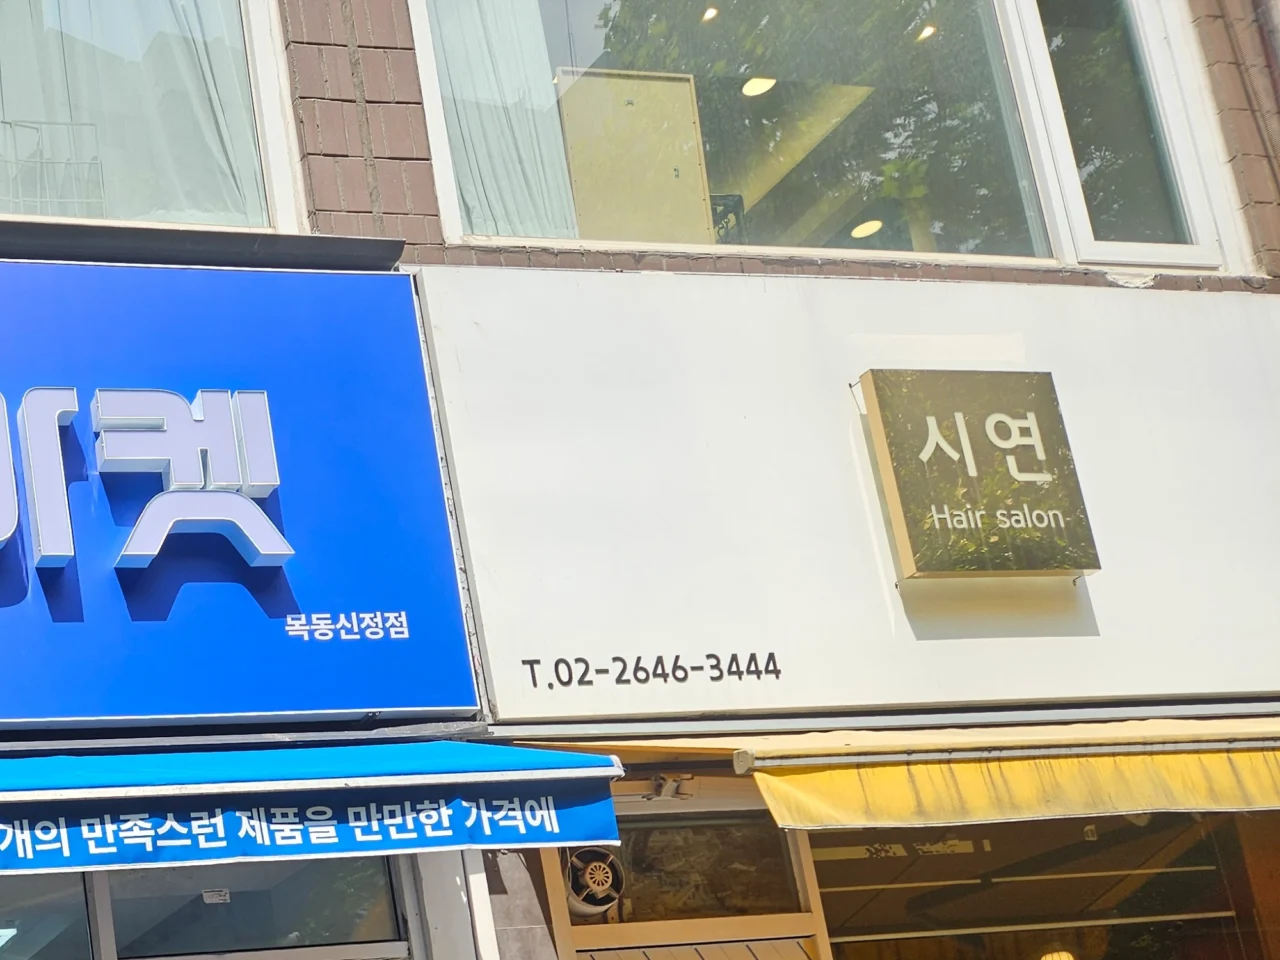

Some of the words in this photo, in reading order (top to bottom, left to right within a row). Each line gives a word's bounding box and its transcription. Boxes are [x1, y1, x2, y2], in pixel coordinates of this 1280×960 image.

[919, 412, 1053, 481] 시연
[931, 503, 985, 529] Hair
[996, 503, 1065, 529] salon
[285, 611, 410, 641] 목동신정점
[522, 652, 782, 690] T.02-2646-3444
[82, 811, 228, 854] 만족스런
[237, 806, 339, 846] 제품을
[348, 800, 454, 841] 만만한
[464, 795, 561, 837] 가격에
